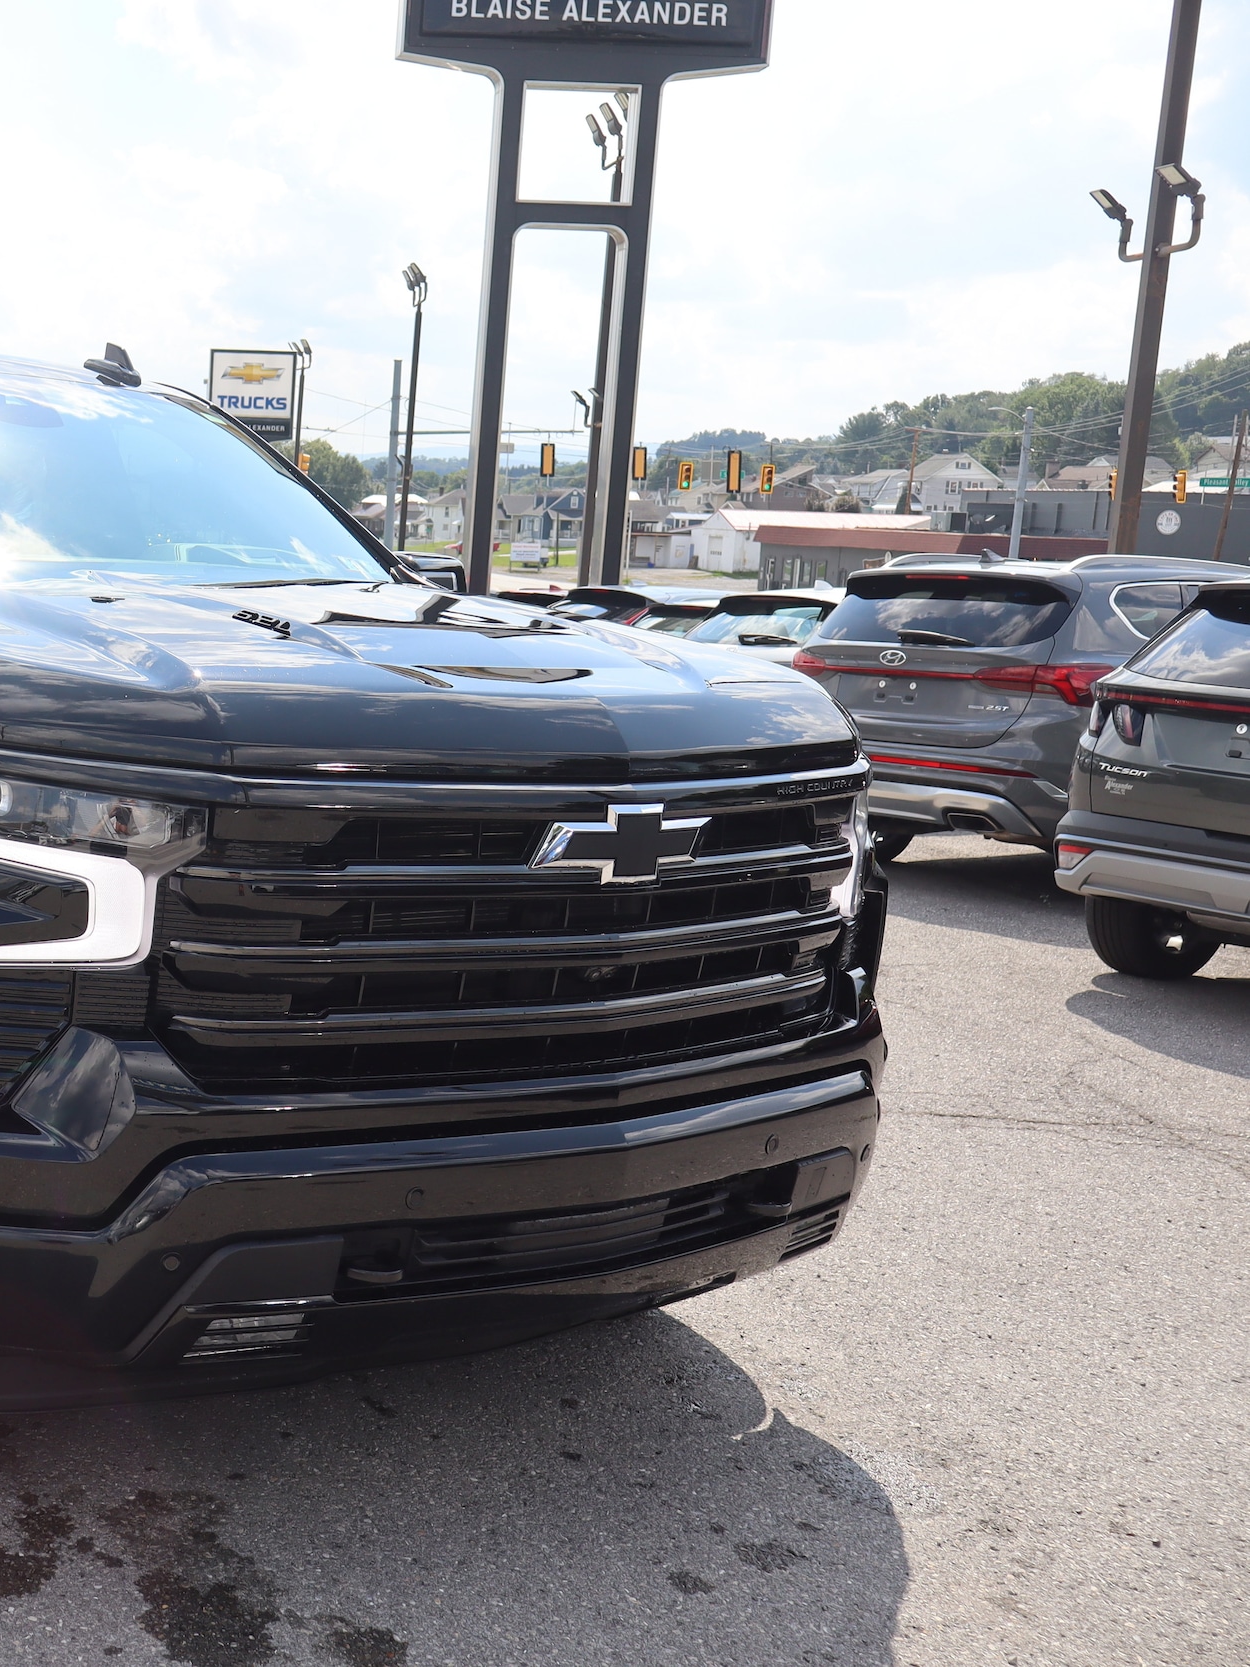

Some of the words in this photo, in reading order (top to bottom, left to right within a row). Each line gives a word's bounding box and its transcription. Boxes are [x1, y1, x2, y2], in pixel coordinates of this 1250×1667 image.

[451, 0, 550, 20] BLAISE
[562, 0, 728, 27] ALEXANDER
[217, 395, 287, 410] TRUCKS
[1203, 478, 1229, 486] Pleasant
[777, 785, 805, 796] HIGH
[807, 779, 853, 792] COUNTRY
